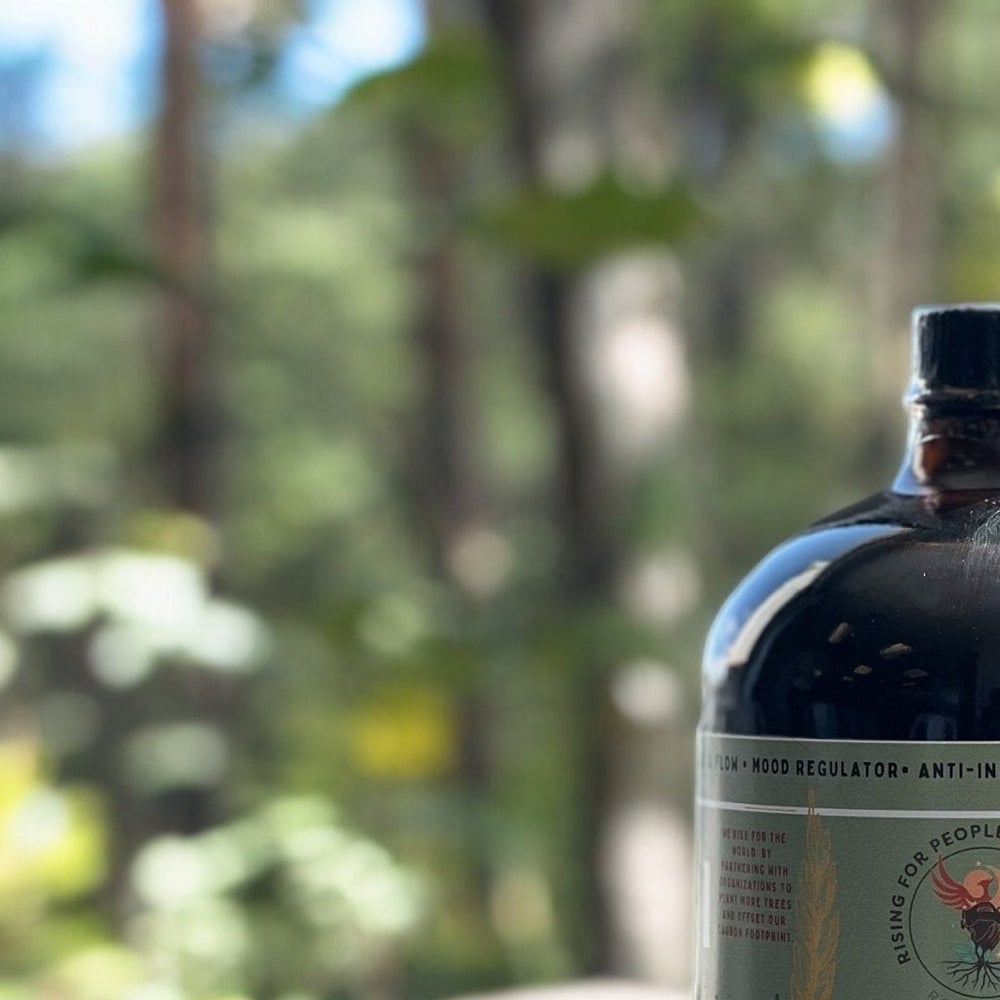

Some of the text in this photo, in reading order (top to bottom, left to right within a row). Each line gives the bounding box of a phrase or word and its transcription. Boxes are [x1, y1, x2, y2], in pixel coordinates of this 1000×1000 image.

[752, 757, 789, 775] MOOD
[796, 760, 898, 778] REGULATOR
[751, 831, 766, 842] FOR
[770, 832, 786, 844] THE
[762, 848, 772, 859] BY
[768, 865, 788, 877] WITH
[898, 851, 929, 888] FOR
[781, 883, 791, 893] TO
[740, 896, 760, 907] MORE
[764, 898, 792, 910] TREES
[722, 909, 786, 926] AND OFFSET OUR
[890, 895, 911, 965] RISING
